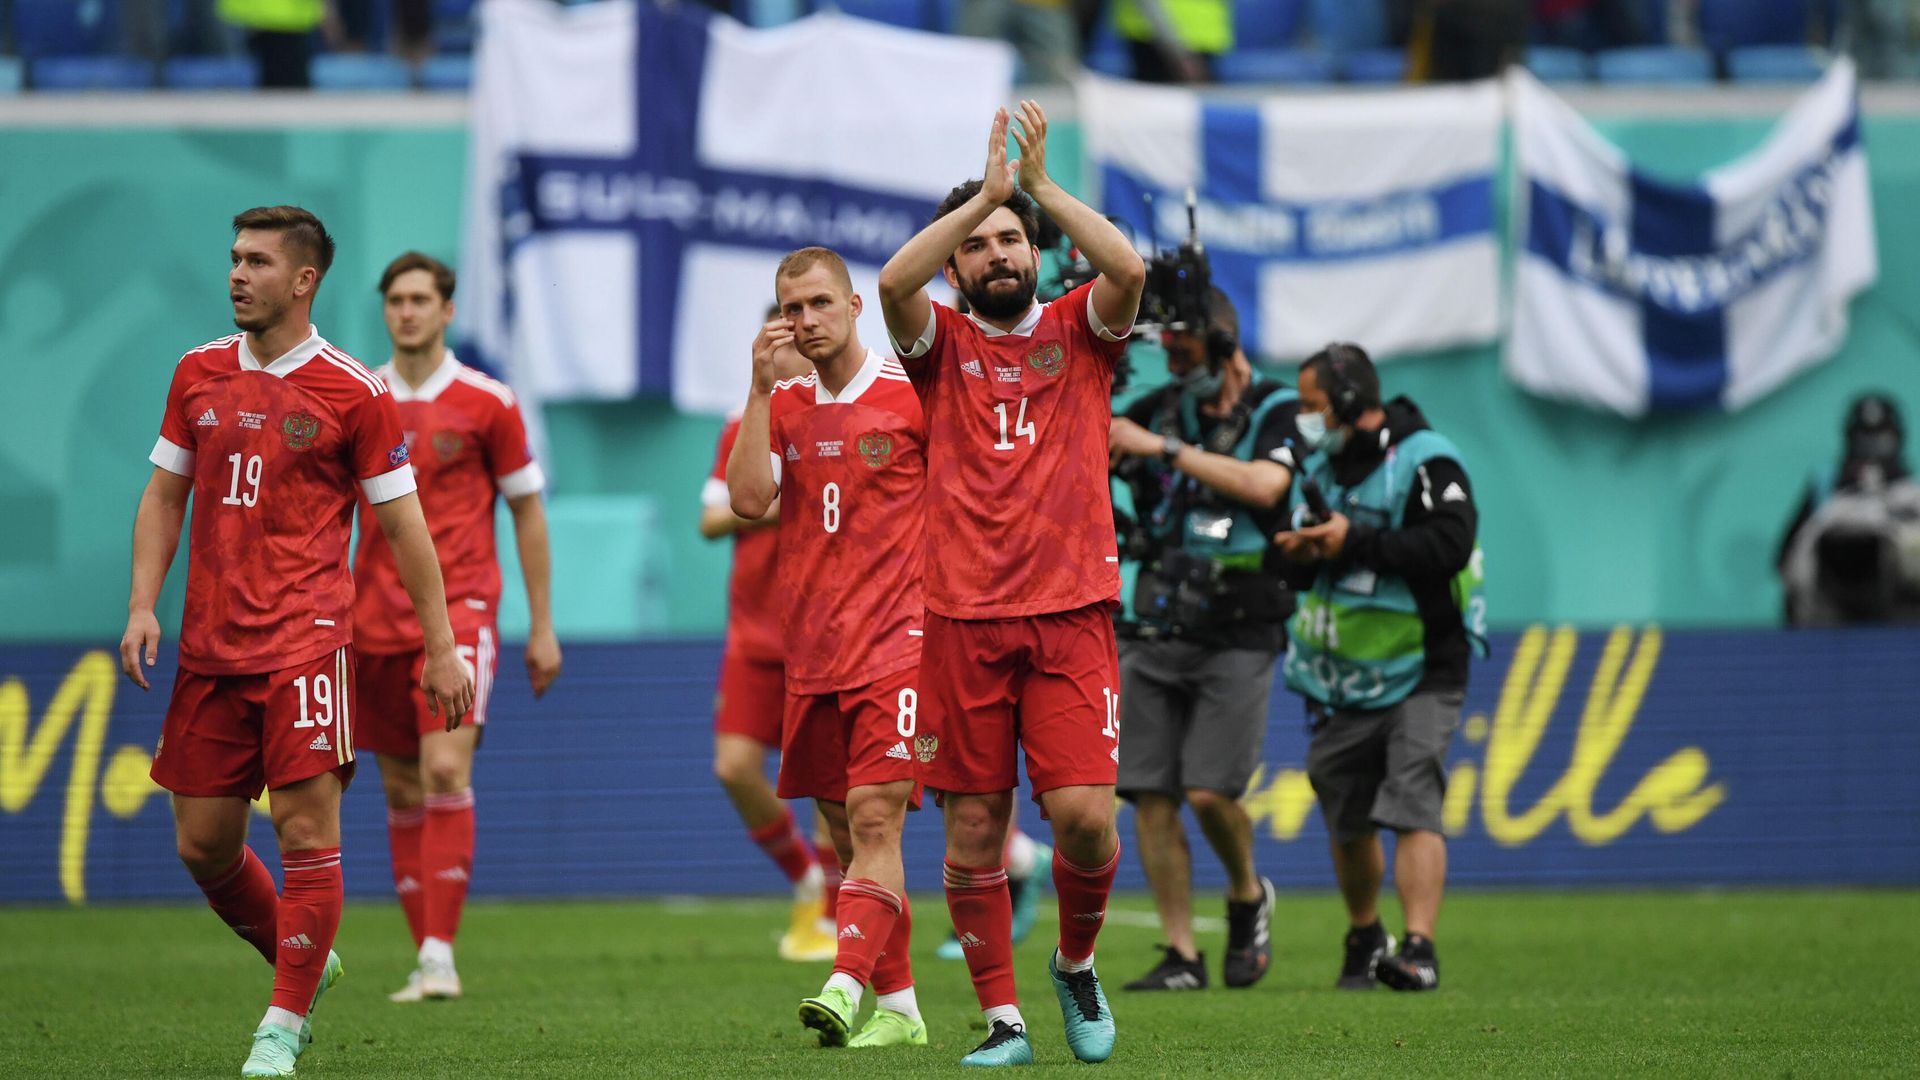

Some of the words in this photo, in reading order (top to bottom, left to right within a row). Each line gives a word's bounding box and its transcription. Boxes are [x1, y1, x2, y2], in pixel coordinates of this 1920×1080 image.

[993, 397, 1036, 451] 14
[222, 452, 263, 508] 19
[823, 482, 840, 533] 8
[293, 674, 333, 728] 19
[897, 687, 917, 737] 8
[886, 750, 911, 760] adidas
